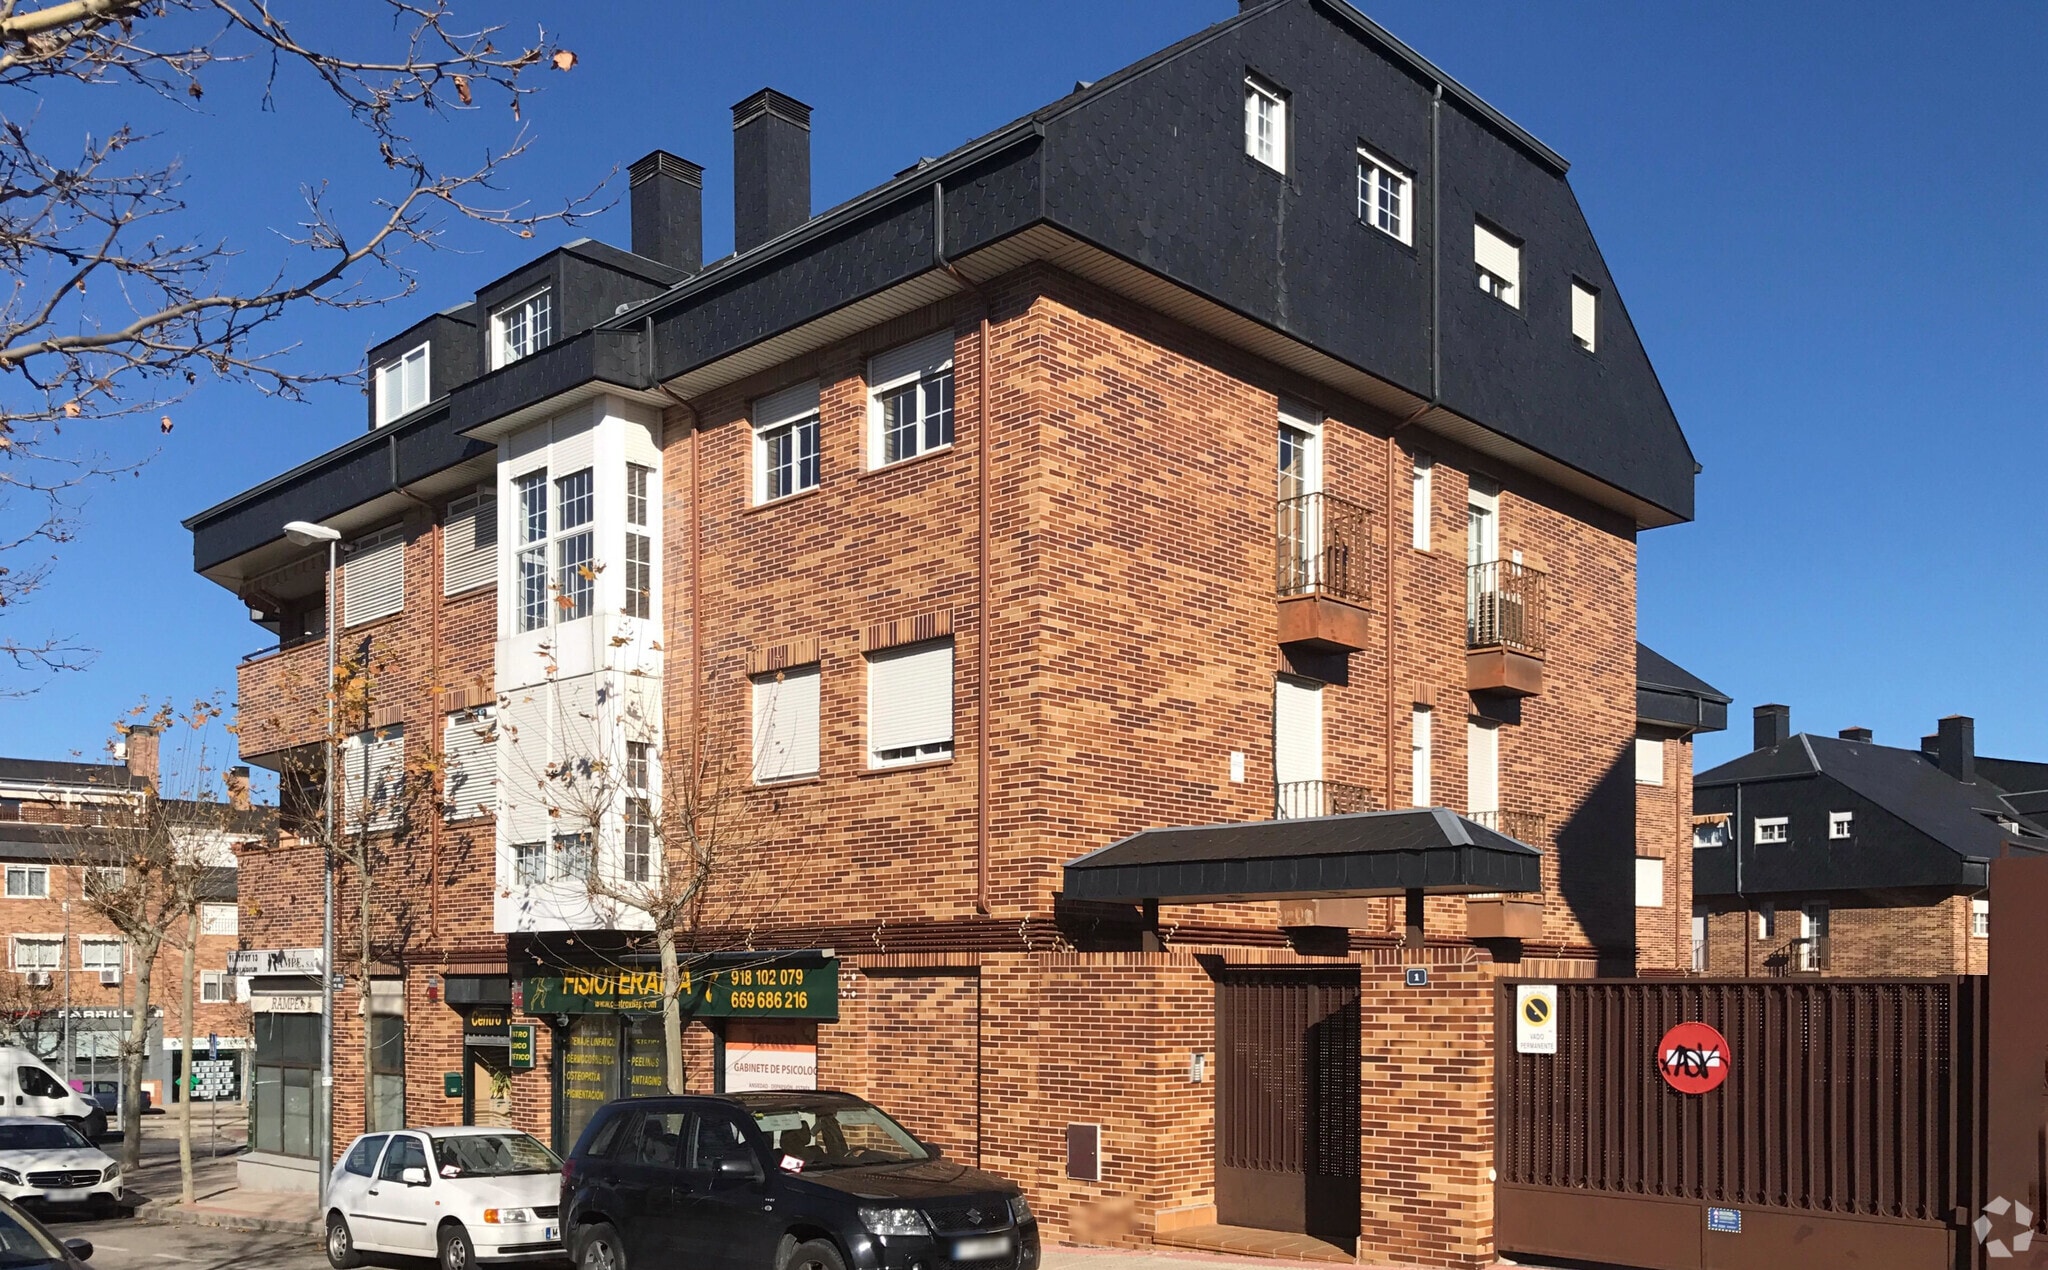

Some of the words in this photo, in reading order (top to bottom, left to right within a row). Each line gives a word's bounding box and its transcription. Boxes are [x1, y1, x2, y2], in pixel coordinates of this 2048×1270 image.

[731, 969, 752, 986] 918
[756, 969, 776, 986] 102
[780, 969, 804, 986] 079
[1414, 973, 1420, 982] 1
[731, 991, 755, 1009] 669
[757, 991, 782, 1009] 686
[784, 991, 808, 1009] 216
[471, 1010, 501, 1026] Centro
[1530, 1033, 1545, 1041] VADO
[1520, 1042, 1554, 1050] PERMANENTE
[734, 1062, 769, 1074] GABINETE
[770, 1064, 780, 1074] DE
